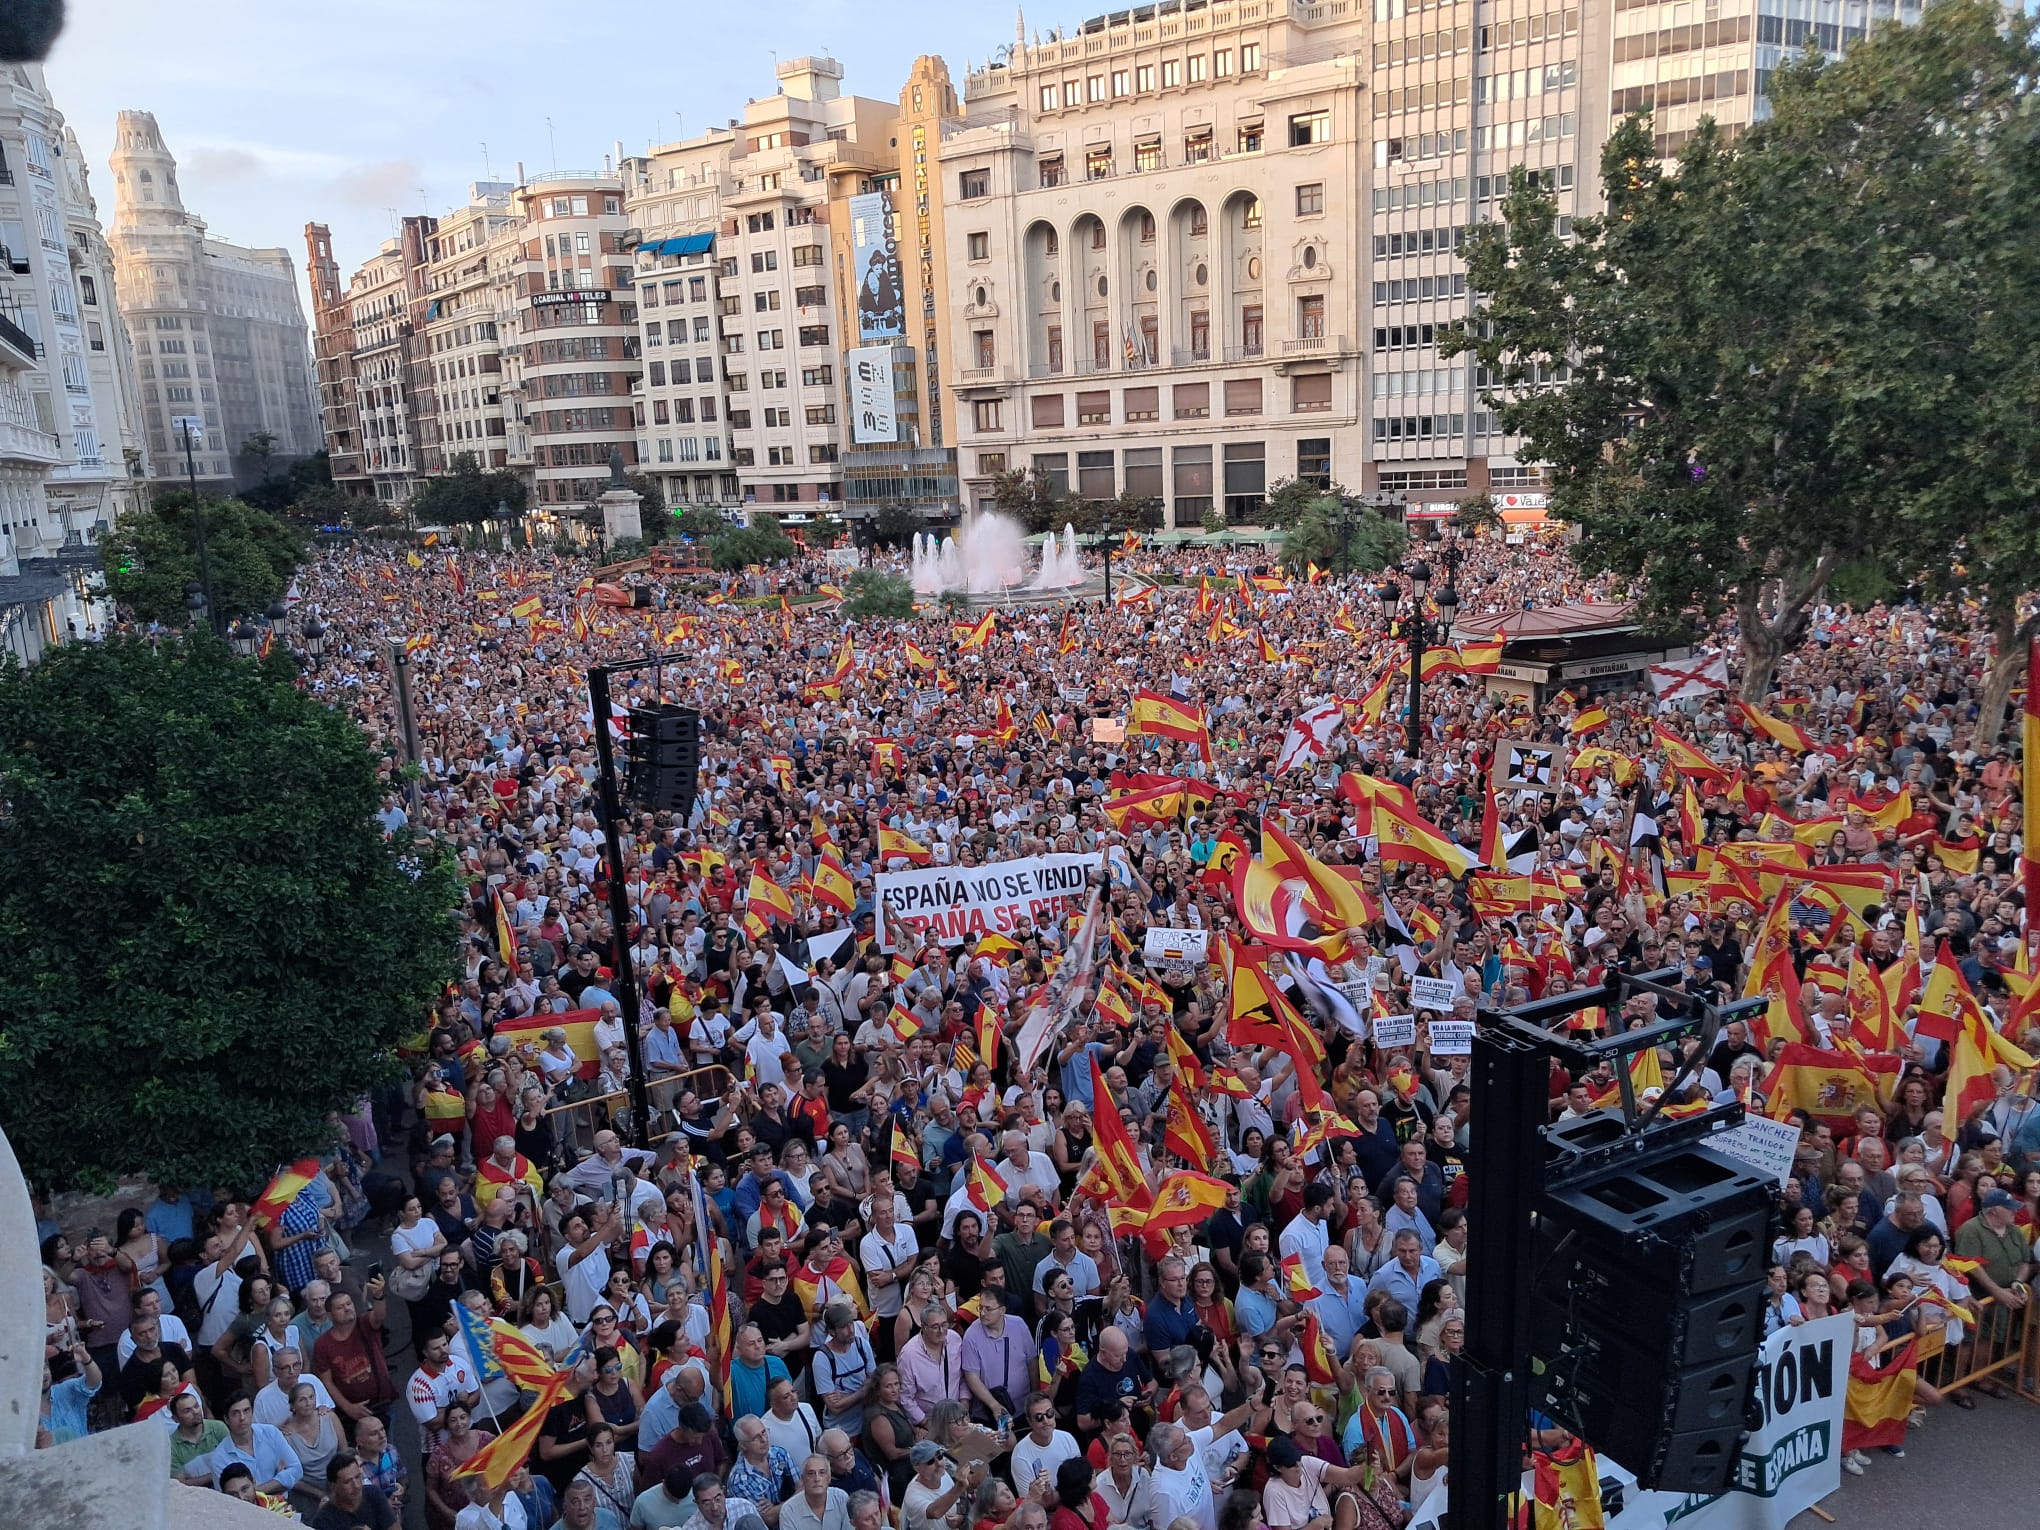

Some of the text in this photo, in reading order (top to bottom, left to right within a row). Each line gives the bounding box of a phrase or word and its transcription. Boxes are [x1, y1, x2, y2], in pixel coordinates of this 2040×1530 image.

[913, 140, 929, 217] RIALTO
[883, 876, 969, 911] ESPAÑA
[970, 877, 1001, 902] NO
[1003, 872, 1032, 898] SE
[1746, 1120, 1796, 1142] SANCHEZ
[1748, 1134, 1785, 1151] TRAIDOR
[1765, 1428, 1824, 1491] ESPAÑA
